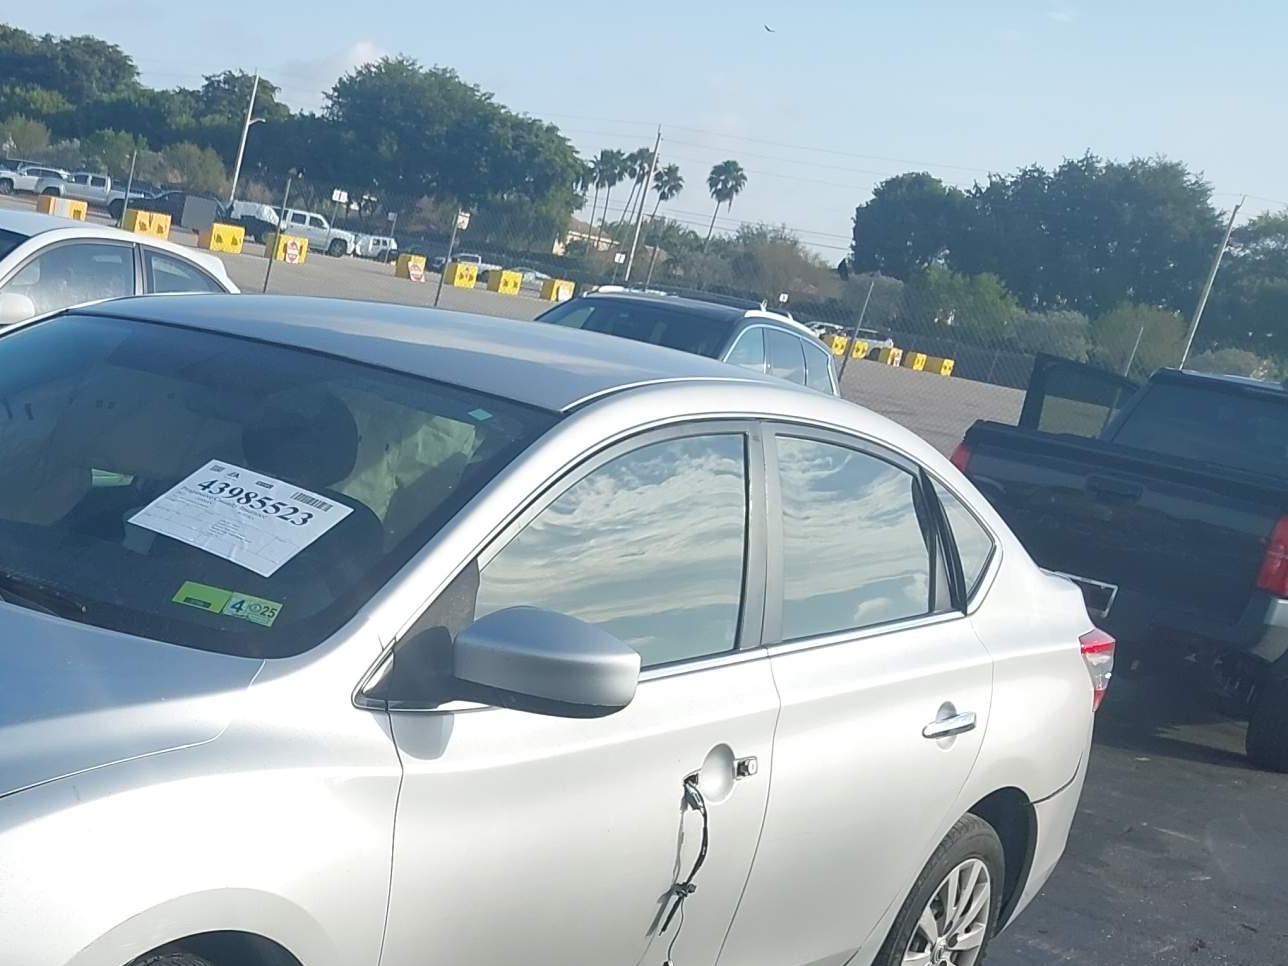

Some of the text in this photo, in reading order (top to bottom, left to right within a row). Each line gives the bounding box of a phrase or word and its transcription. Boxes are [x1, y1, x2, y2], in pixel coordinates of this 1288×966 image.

[197, 479, 314, 527] 43985523
[231, 600, 278, 619] 4 25
